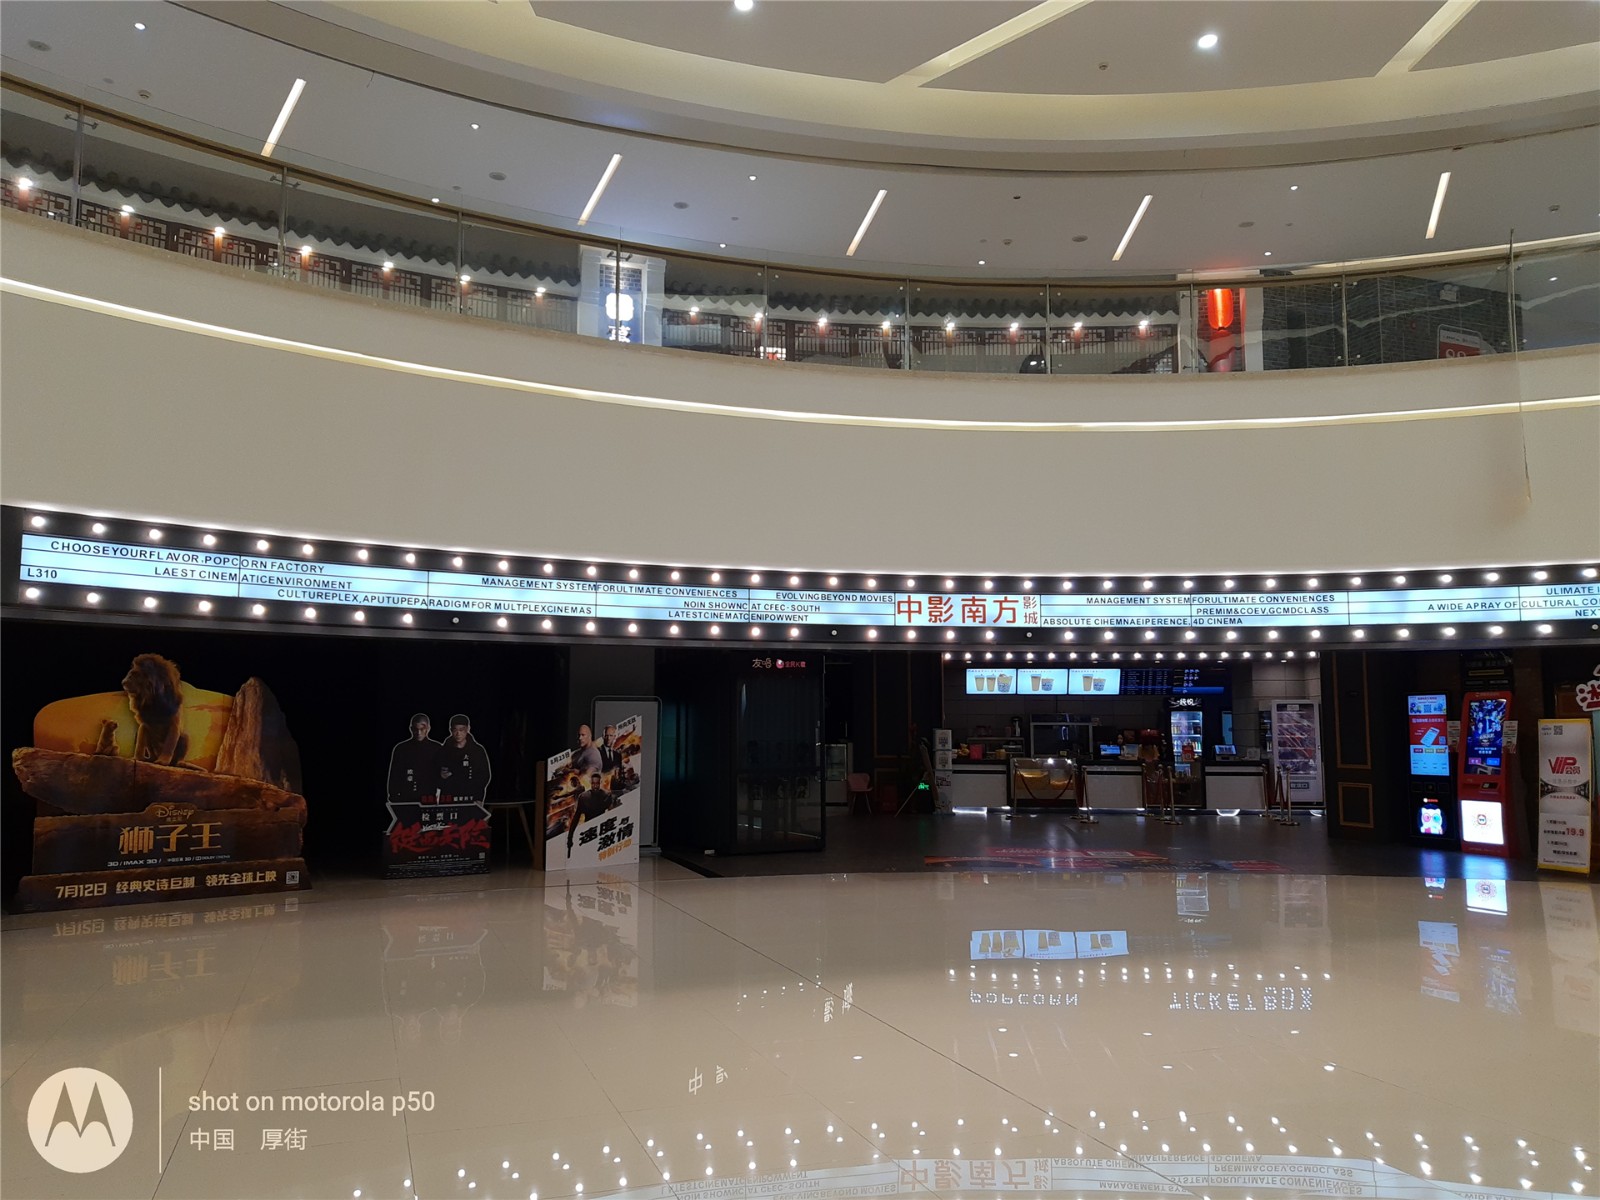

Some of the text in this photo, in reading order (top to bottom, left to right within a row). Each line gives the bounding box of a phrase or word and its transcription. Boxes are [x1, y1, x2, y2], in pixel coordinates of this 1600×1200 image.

[27, 567, 58, 579] L310
[271, 562, 325, 574] FACTORY
[481, 577, 553, 589] MANAGEMENT
[665, 587, 738, 598] CONVENIENCES
[1545, 586, 1594, 596] ULIMATE
[859, 594, 893, 602] MOVIES
[1086, 596, 1150, 604] MANAGEMENT
[1259, 594, 1335, 603] CONVENIENCES
[896, 594, 1019, 624] 中影南方
[1022, 595, 1038, 625] 影城
[1437, 603, 1463, 611] WIDE
[1504, 601, 1518, 609] OF
[1521, 599, 1578, 608] CULTURAL
[1574, 608, 1600, 617] NEX
[1042, 618, 1092, 626] ABSOLUTE
[1207, 617, 1243, 625] CINEMA
[119, 821, 223, 855] 狮子王
[1565, 827, 1585, 837] 19.9
[55, 870, 277, 899] 7月12日 经典史诗巨制 领先全球上映
